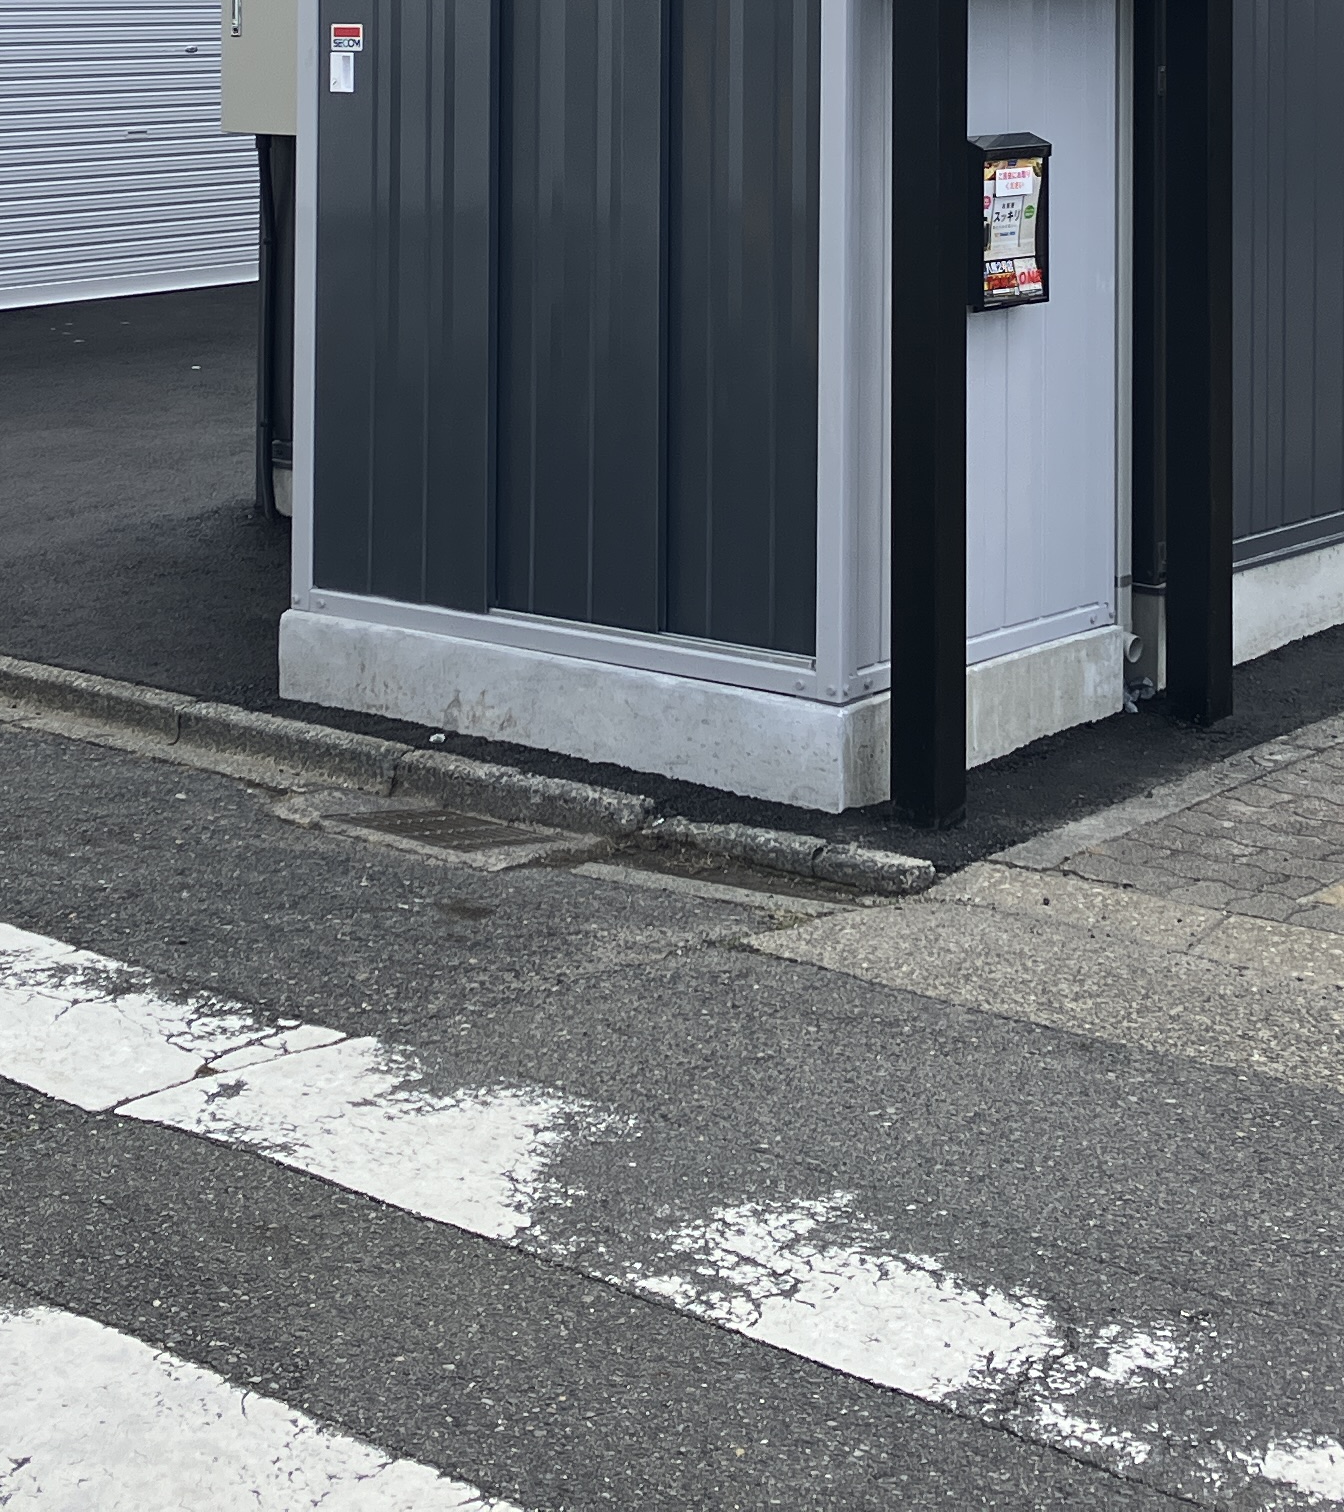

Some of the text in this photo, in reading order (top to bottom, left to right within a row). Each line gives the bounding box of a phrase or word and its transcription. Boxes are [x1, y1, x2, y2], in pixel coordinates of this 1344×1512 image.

[333, 38, 361, 48] SECOM
[993, 209, 1021, 223] スッキリ
